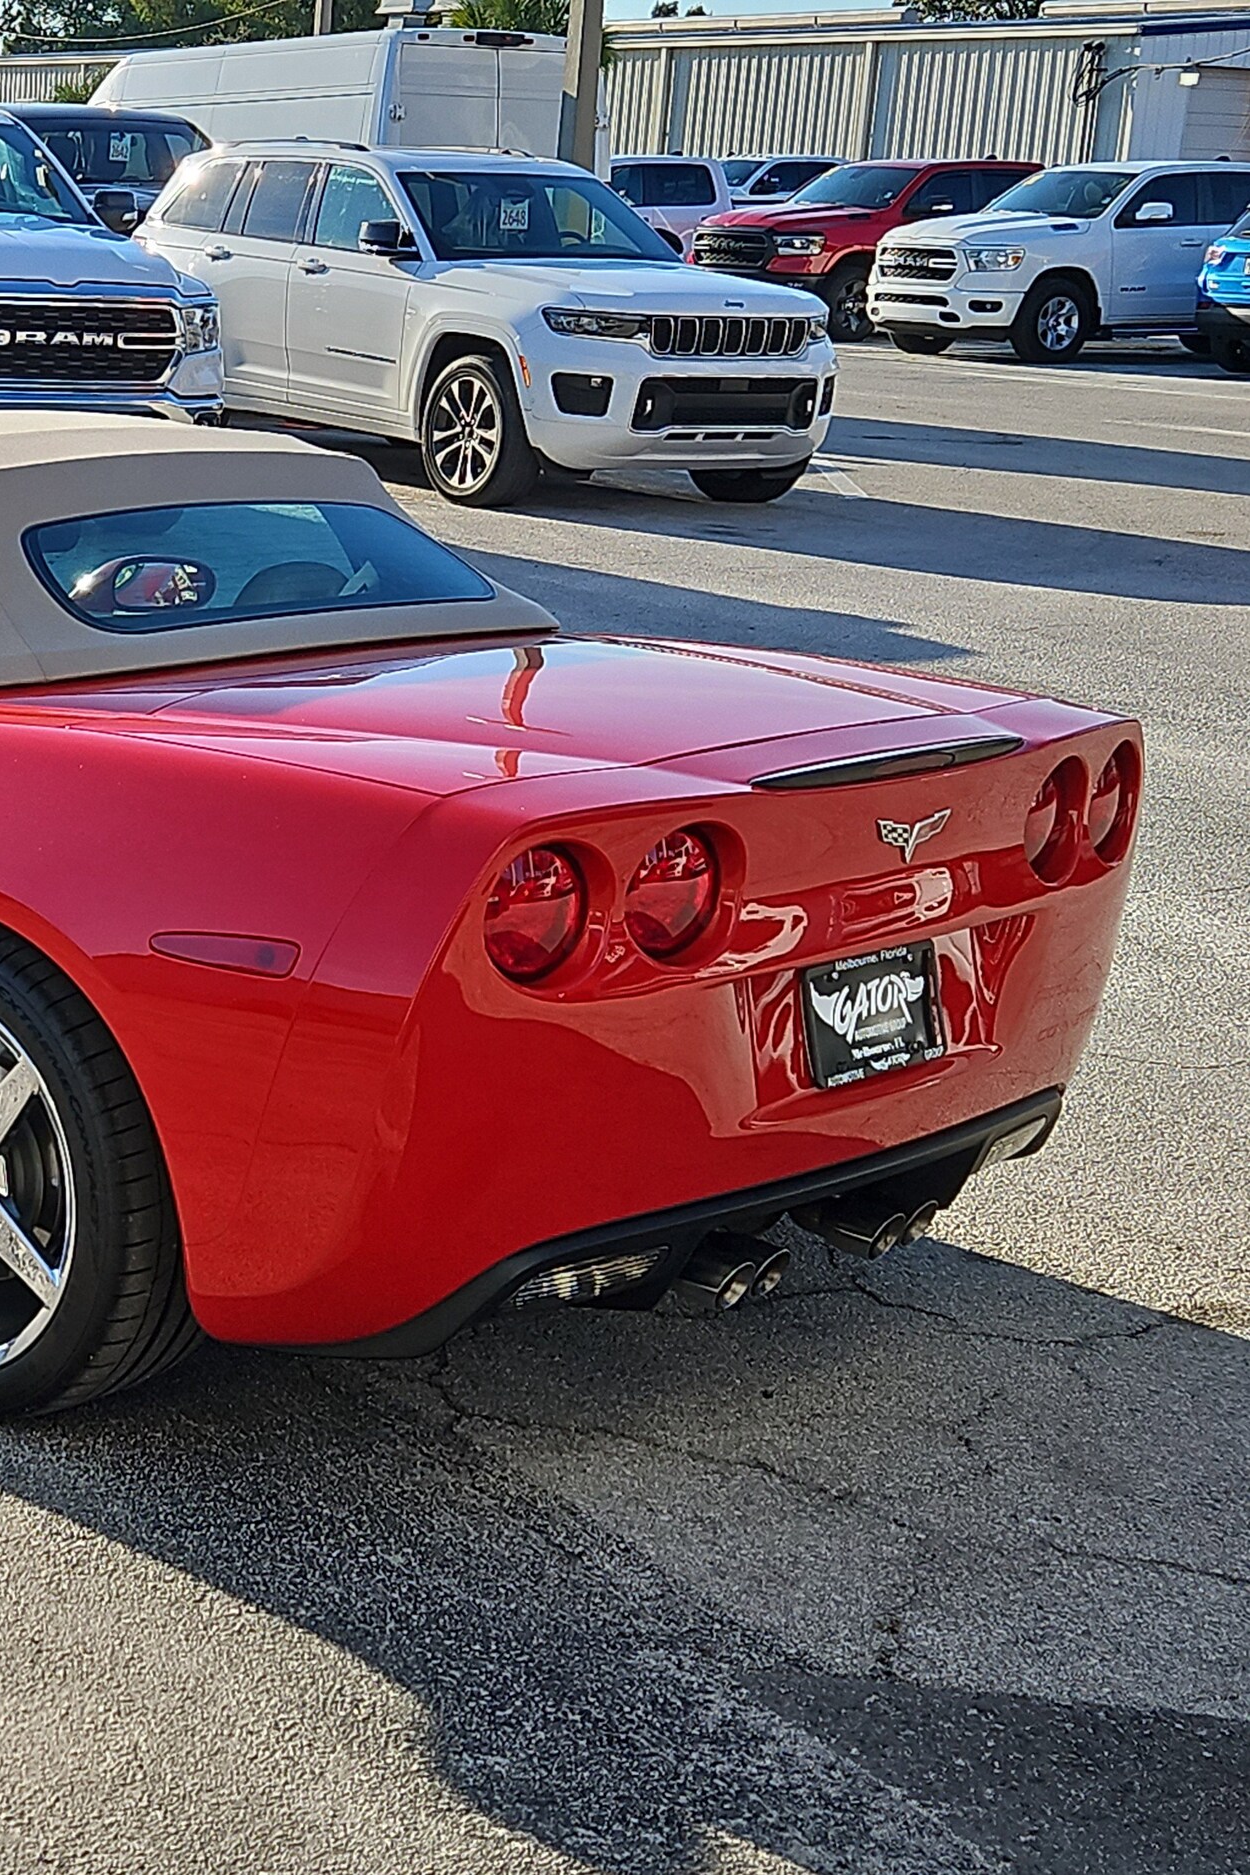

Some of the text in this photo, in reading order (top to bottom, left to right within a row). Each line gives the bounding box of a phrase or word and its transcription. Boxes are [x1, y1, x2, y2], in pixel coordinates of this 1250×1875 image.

[502, 209, 526, 227] 2648
[15, 330, 115, 346] RAM
[833, 974, 913, 1045] GATOR
